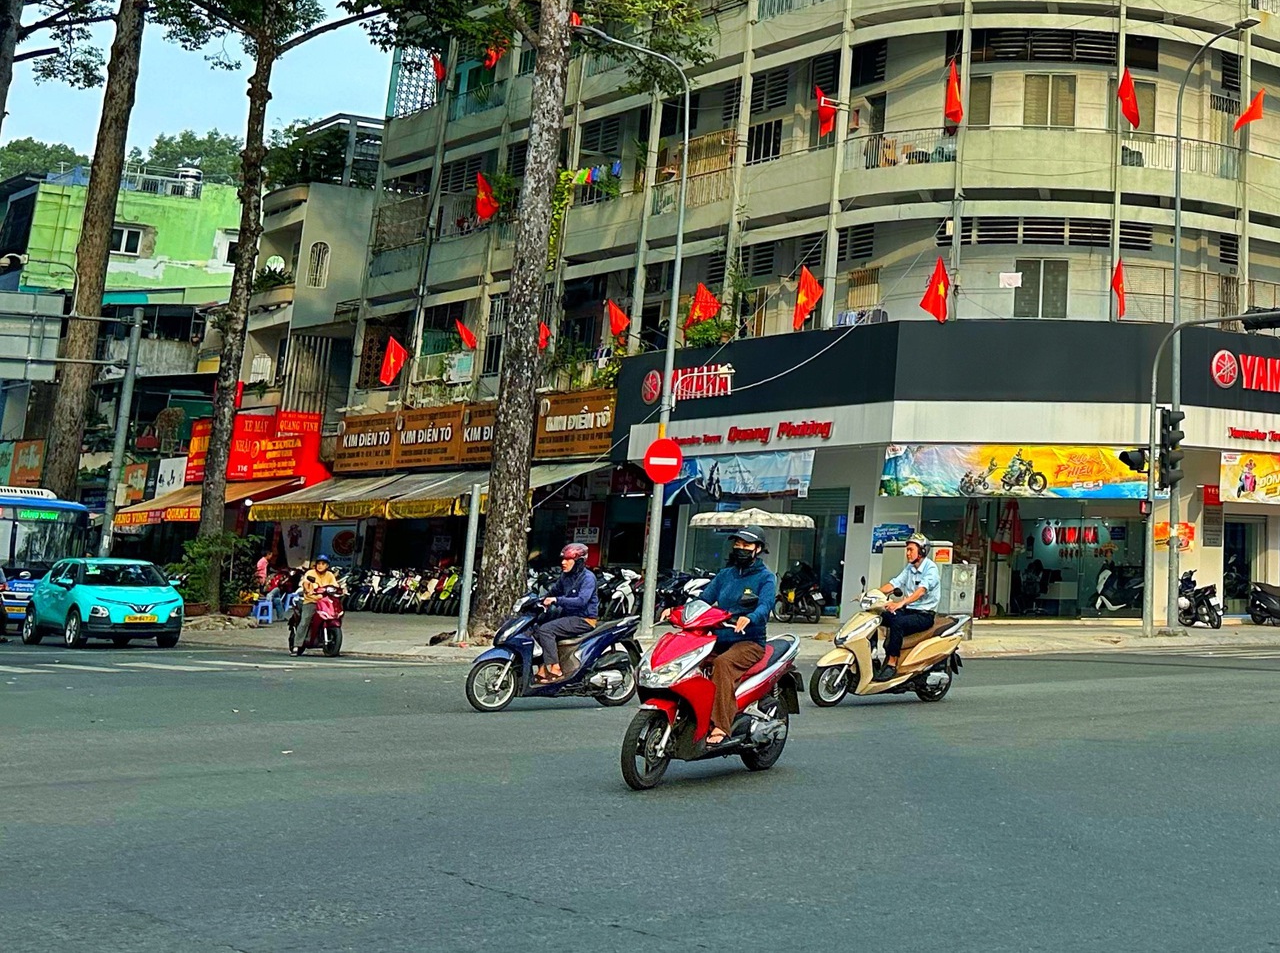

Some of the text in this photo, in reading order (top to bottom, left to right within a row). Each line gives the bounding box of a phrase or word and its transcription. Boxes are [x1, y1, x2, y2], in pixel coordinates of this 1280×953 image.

[595, 405, 611, 428] TÔ
[343, 434, 358, 447] KIM
[379, 427, 390, 445] TÔ
[400, 429, 416, 444] KIM
[440, 422, 451, 441] TÔ
[464, 427, 481, 442] KIM
[728, 425, 773, 444] Quang
